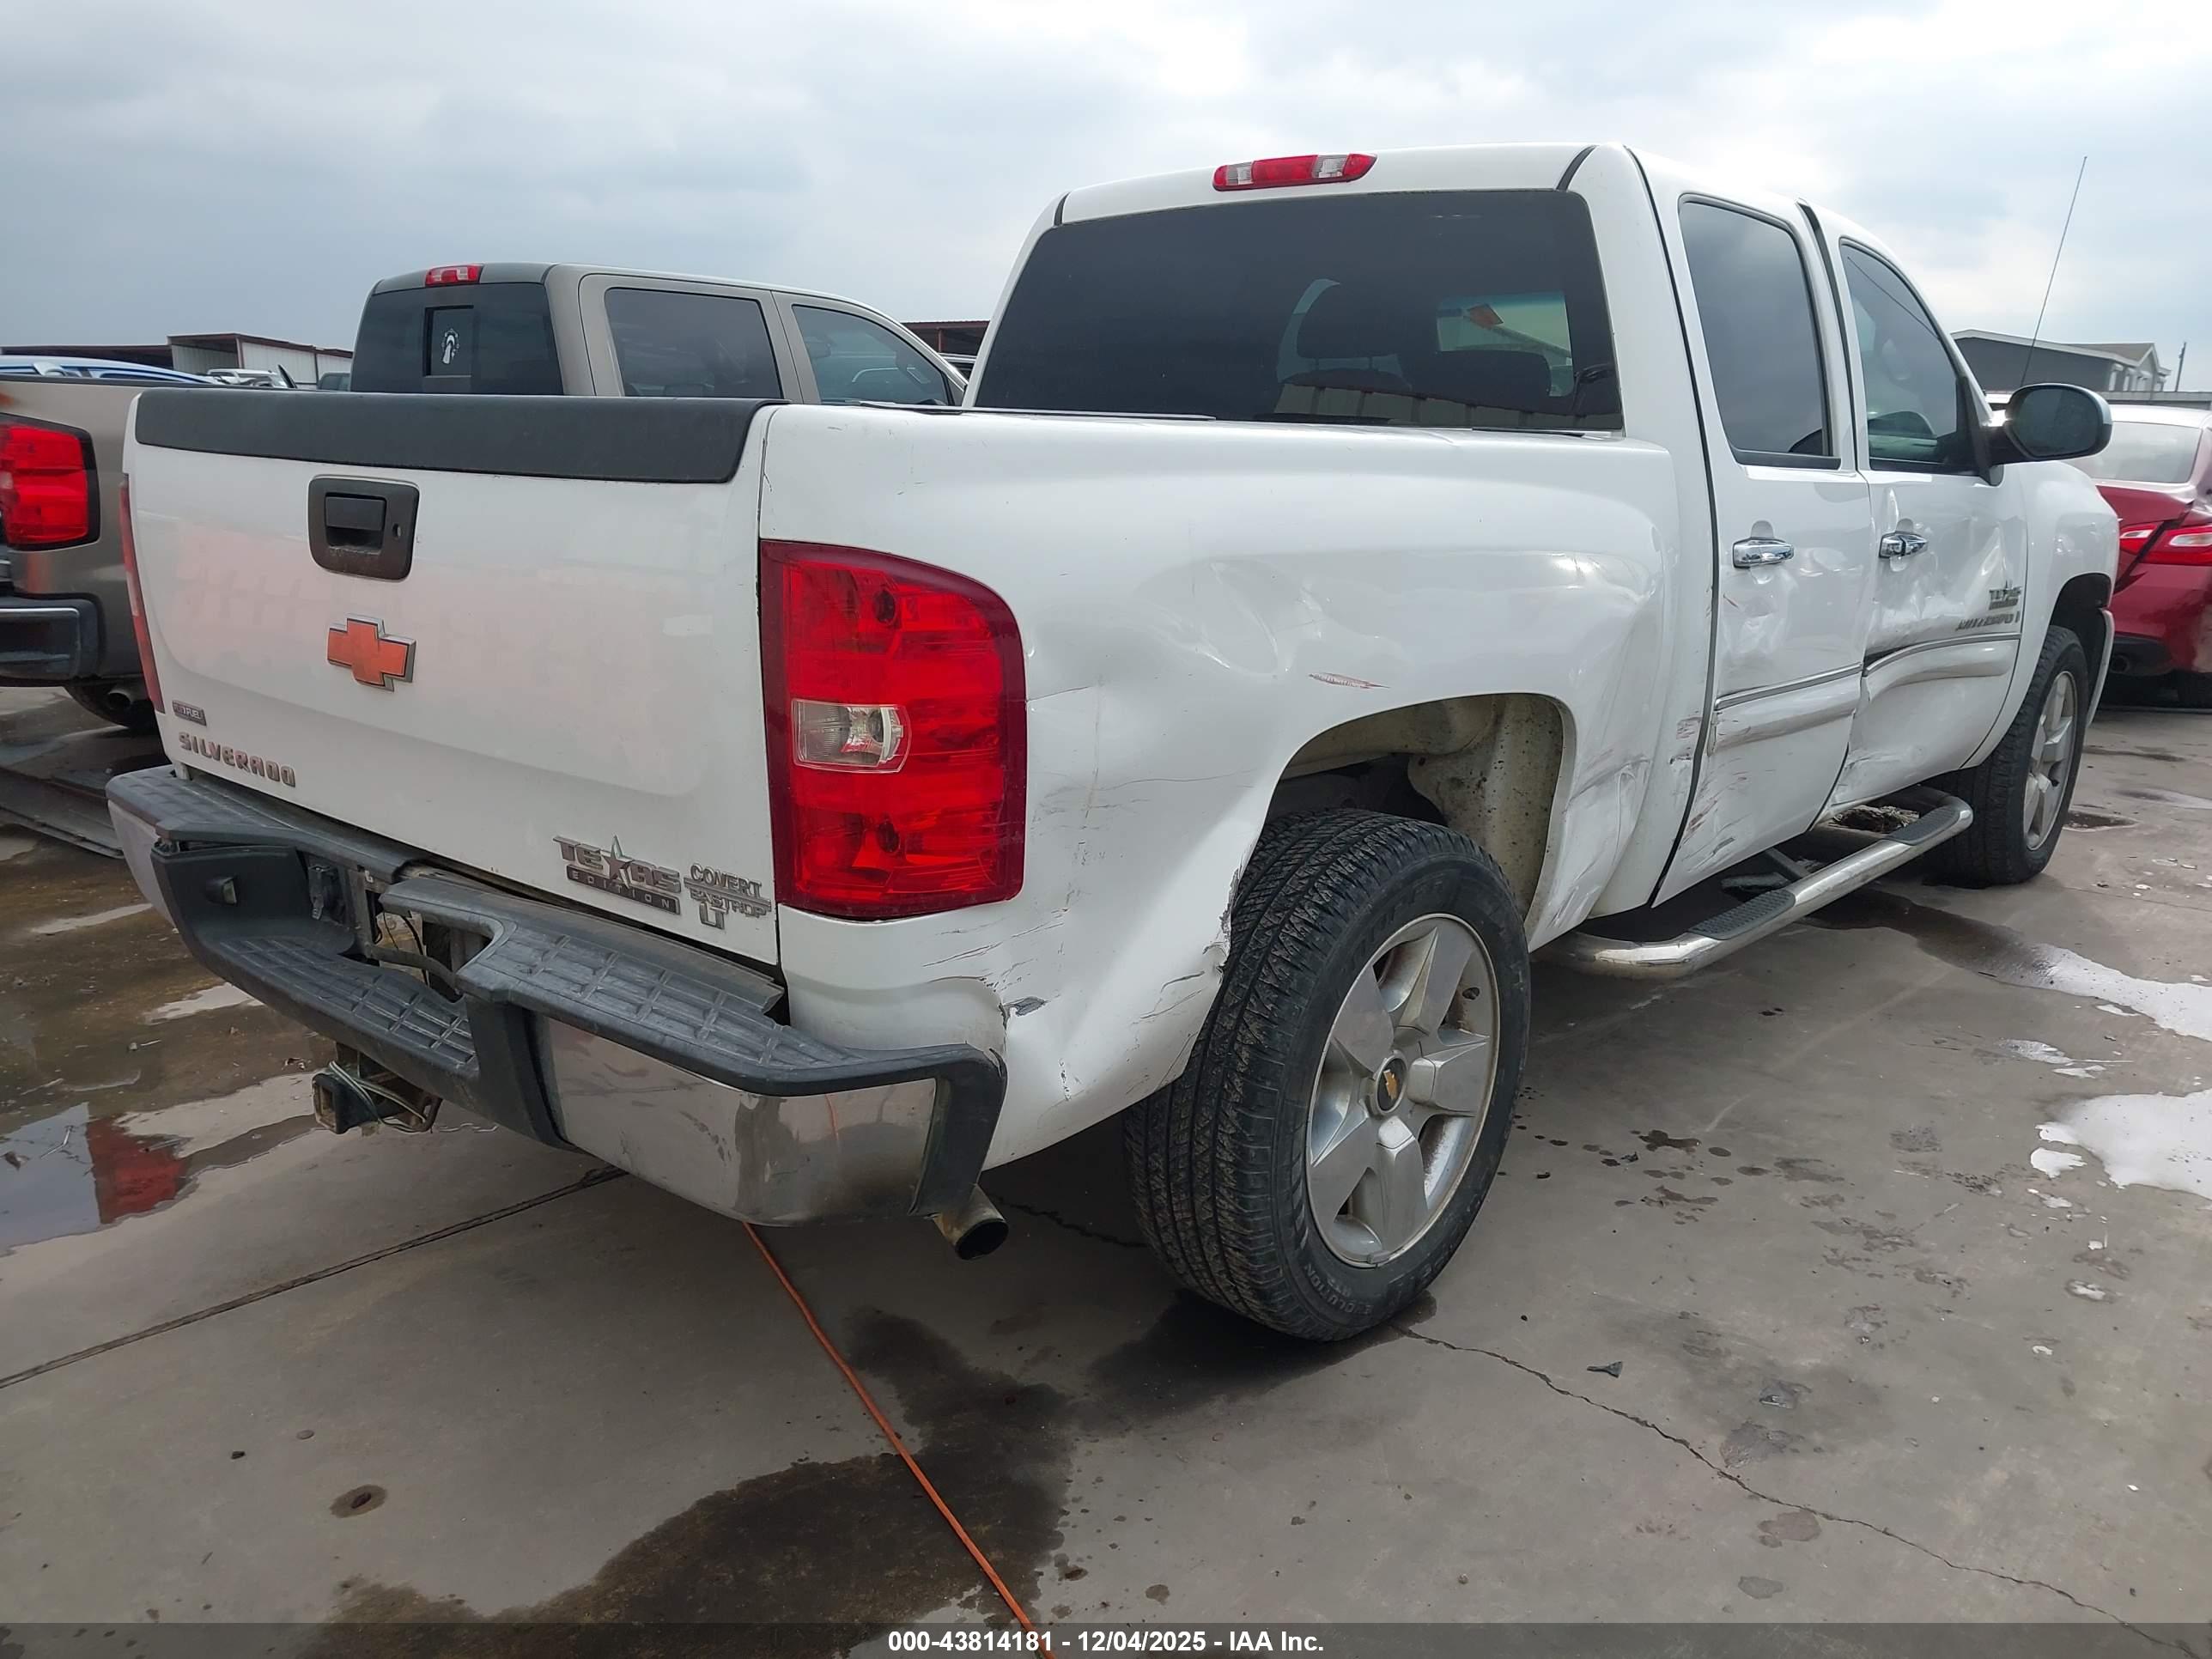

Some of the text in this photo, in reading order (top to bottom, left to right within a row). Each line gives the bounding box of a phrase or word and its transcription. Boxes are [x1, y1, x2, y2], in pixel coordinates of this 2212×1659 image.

[179, 732, 295, 787] SILVERADO
[571, 870, 672, 908] EDITION
[690, 862, 762, 899] COVERT
